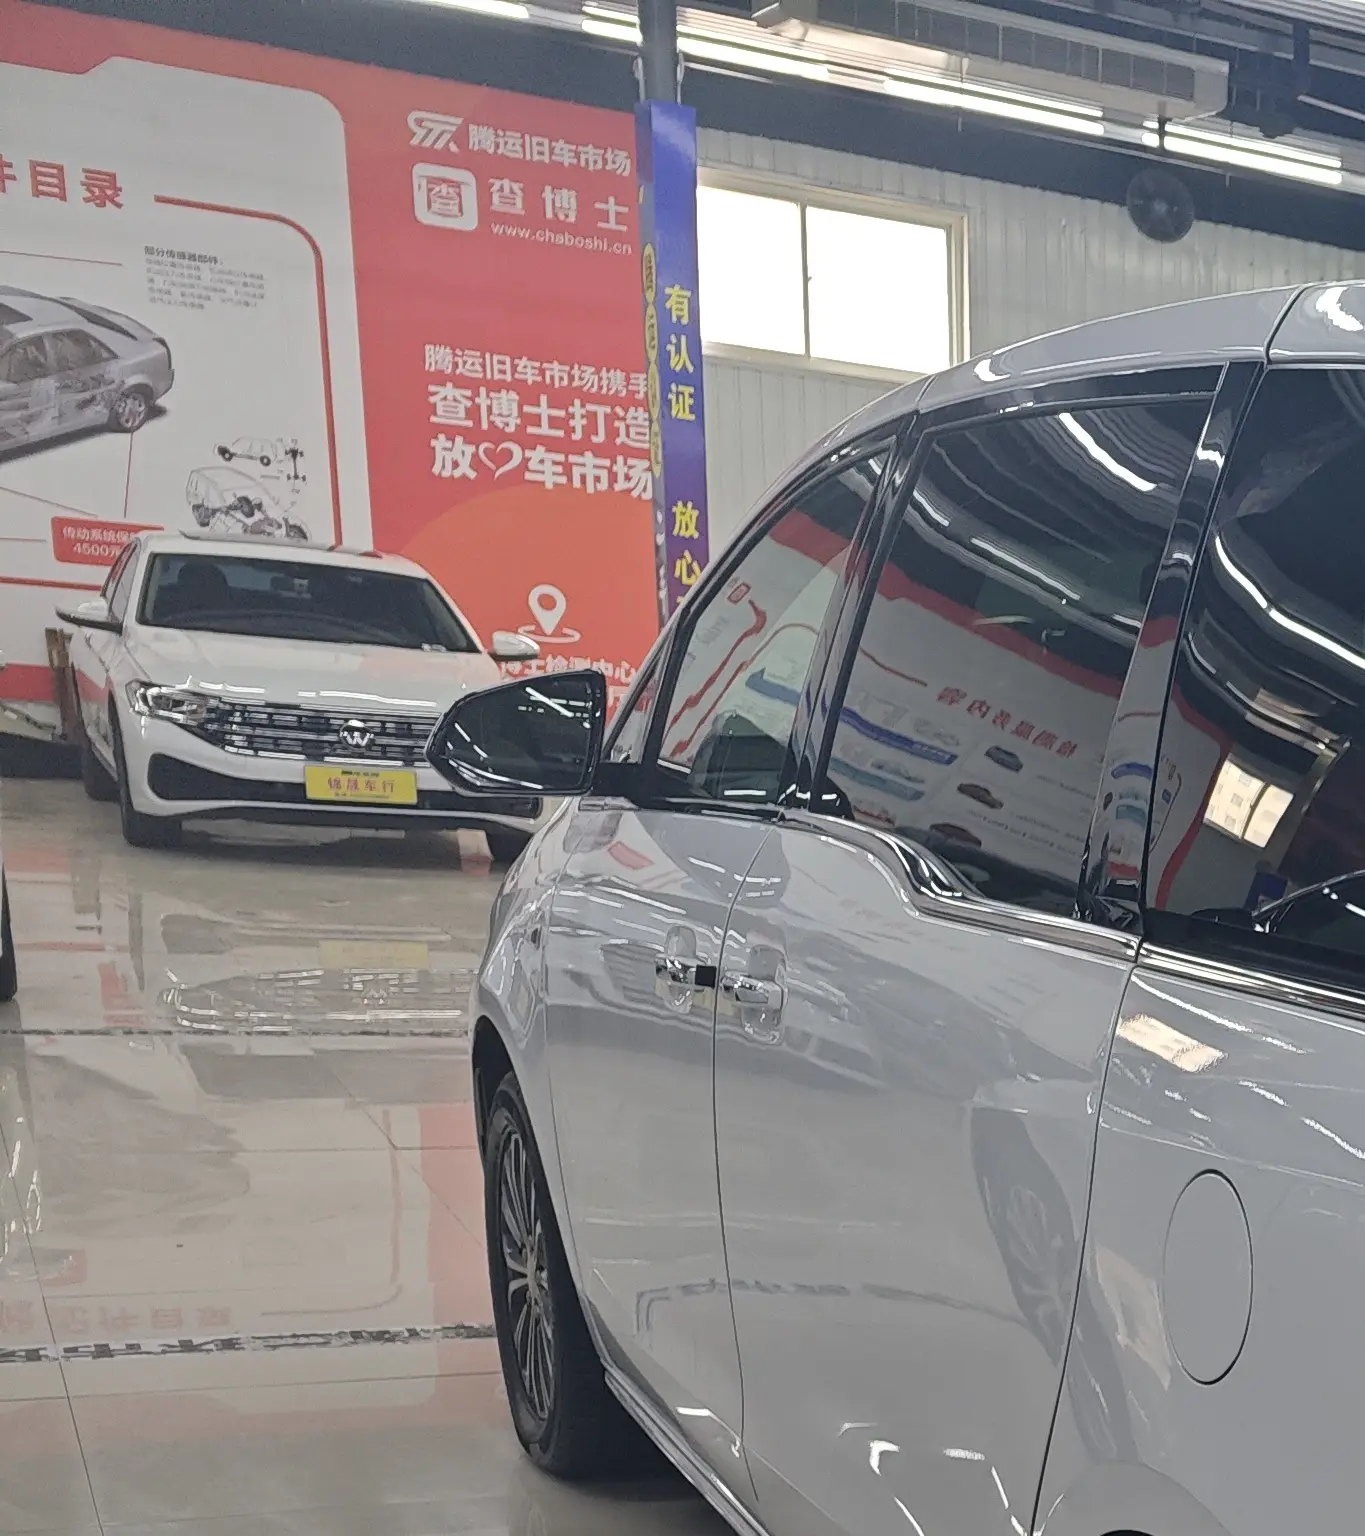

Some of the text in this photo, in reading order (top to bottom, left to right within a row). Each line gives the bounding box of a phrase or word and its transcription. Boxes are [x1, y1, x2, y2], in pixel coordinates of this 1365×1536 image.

[468, 123, 632, 177] 腾运旧车市场
[488, 177, 629, 232] 查博士
[490, 222, 632, 255] www.chaboshi.cn
[424, 343, 649, 400] 腾运旧车市场携手
[428, 382, 651, 450] 查博士打造
[524, 444, 652, 501] 车市场
[664, 284, 703, 606] 有认证 放心
